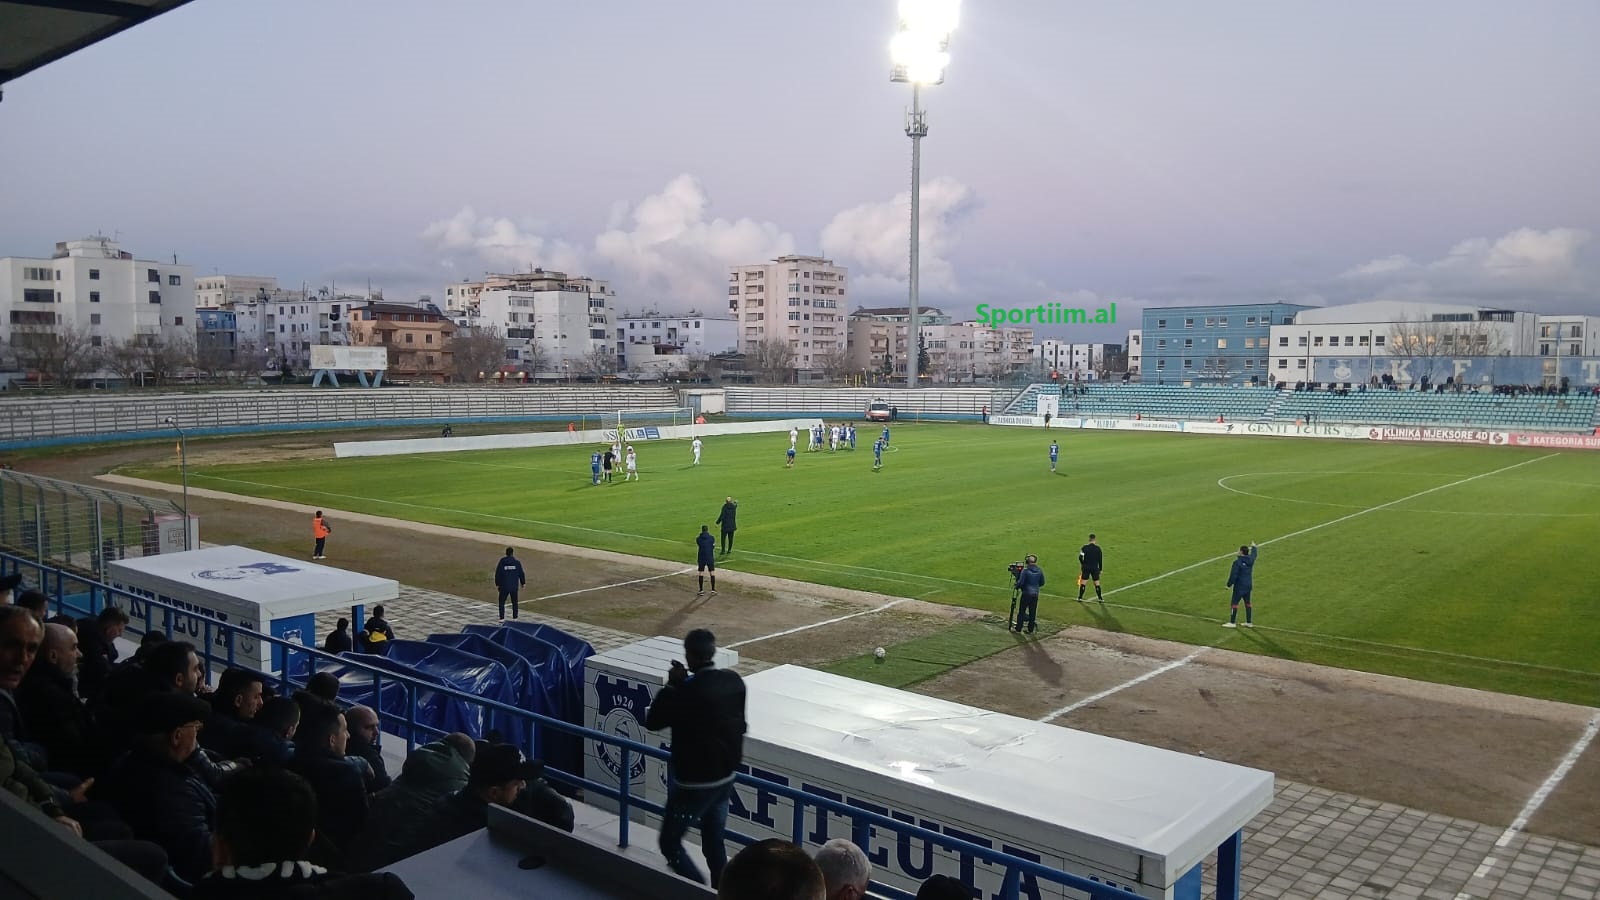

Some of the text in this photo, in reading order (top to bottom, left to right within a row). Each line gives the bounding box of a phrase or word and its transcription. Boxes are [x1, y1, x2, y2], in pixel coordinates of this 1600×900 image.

[1247, 423, 1288, 433] GENTI
[608, 430, 638, 441] SIAL
[1383, 428, 1421, 438] KLINIKA
[1423, 429, 1474, 440] MJEKSORE
[1475, 431, 1489, 441] 4D
[1533, 435, 1583, 446] KATEGORIA
[612, 694, 635, 711] 1920
